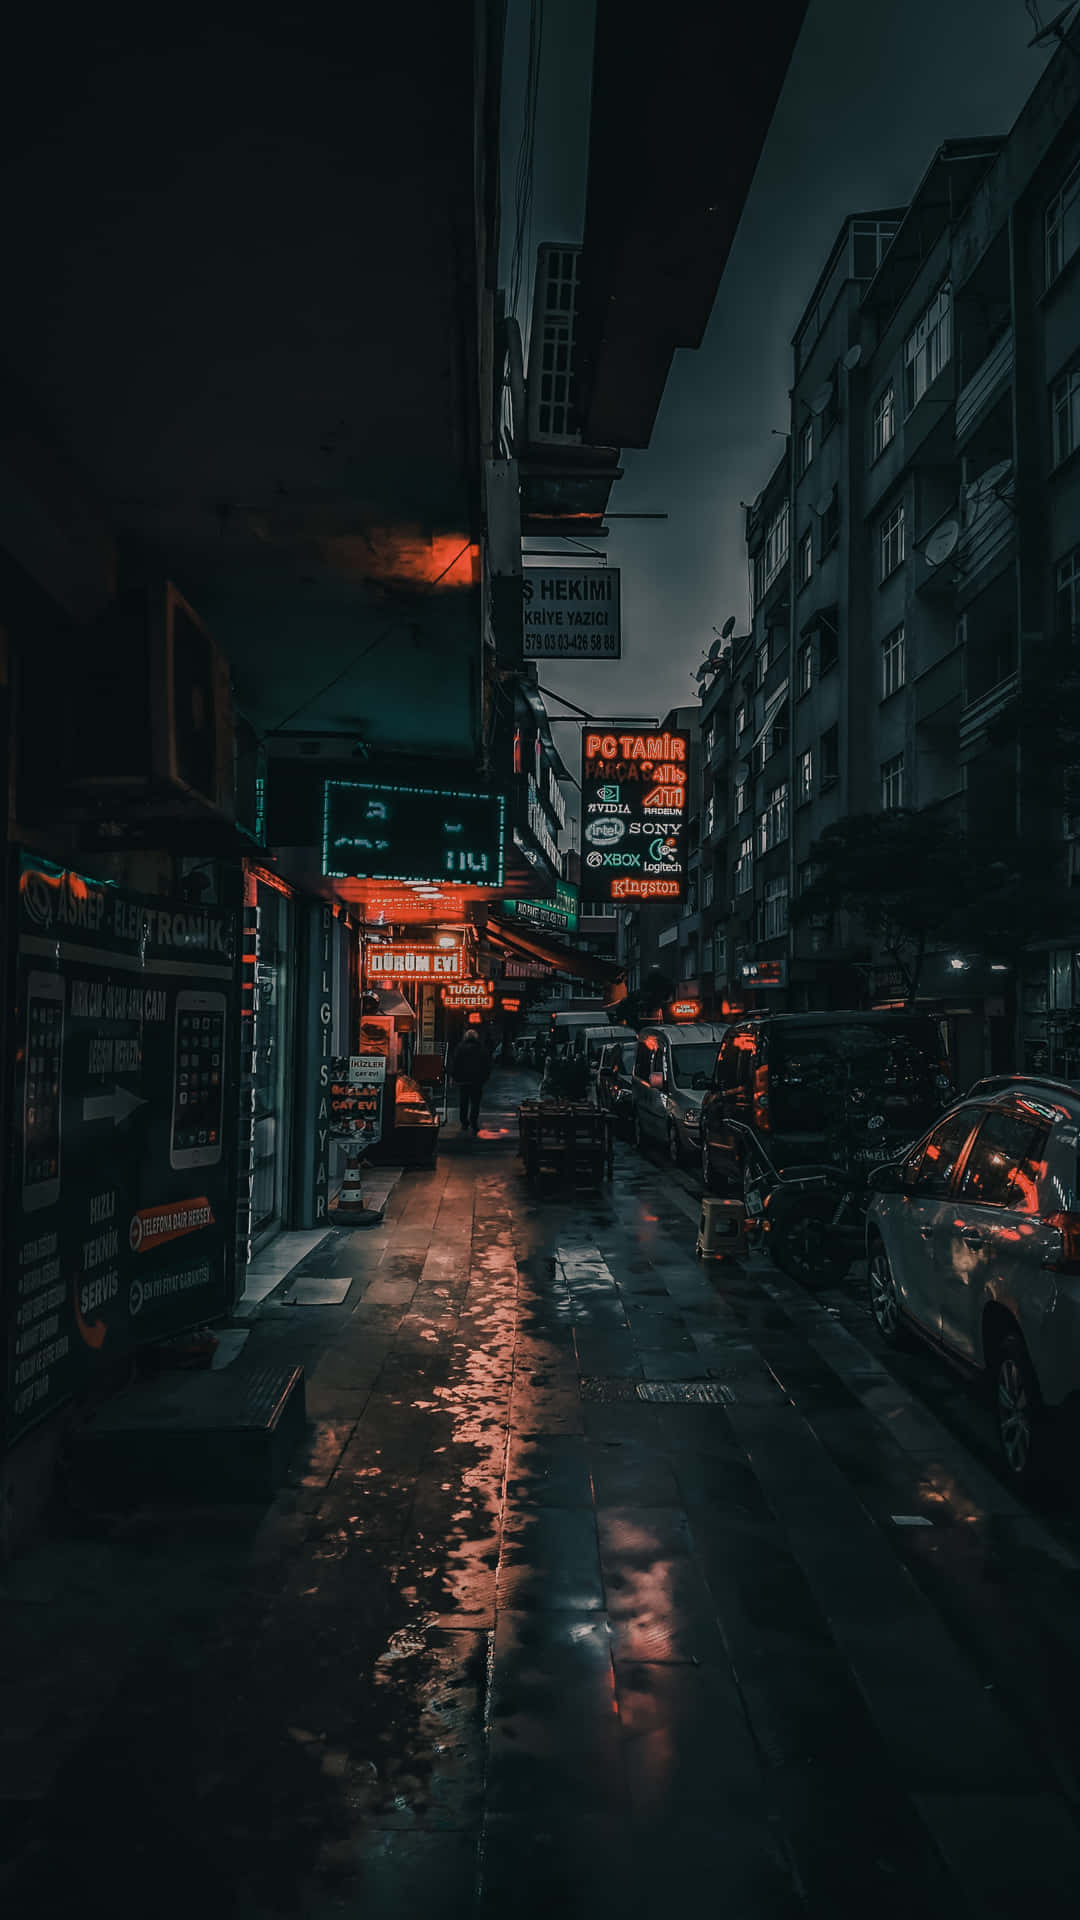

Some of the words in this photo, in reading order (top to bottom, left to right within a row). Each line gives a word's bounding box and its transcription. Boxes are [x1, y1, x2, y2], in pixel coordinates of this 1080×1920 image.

[541, 576, 611, 601] HEKİMİ
[567, 611, 609, 627] YAZICI
[525, 633, 542, 650] 579
[545, 633, 556, 650] 03
[586, 735, 618, 760] PC
[619, 732, 686, 762] TAMİR
[585, 761, 641, 783] PARÇA
[640, 761, 688, 785] SATIŞ
[644, 807, 683, 816] RADEON
[591, 823, 619, 837] intel
[629, 822, 682, 835] SONY
[602, 852, 641, 868] XBOX
[643, 860, 682, 874] Logitech
[611, 877, 681, 899] Kingston
[371, 952, 430, 972] DÜRÜM
[433, 953, 459, 972] EVİ
[448, 982, 486, 995] TUĞRA
[445, 996, 489, 1006] ELEKTRİK
[316, 907, 331, 1219] BİLGİSAYAR
[90, 1192, 115, 1225] HIZLI
[143, 1213, 173, 1238] TELEFONA
[83, 1226, 119, 1271] TEKNİK
[81, 1266, 119, 1314] SERVİS
